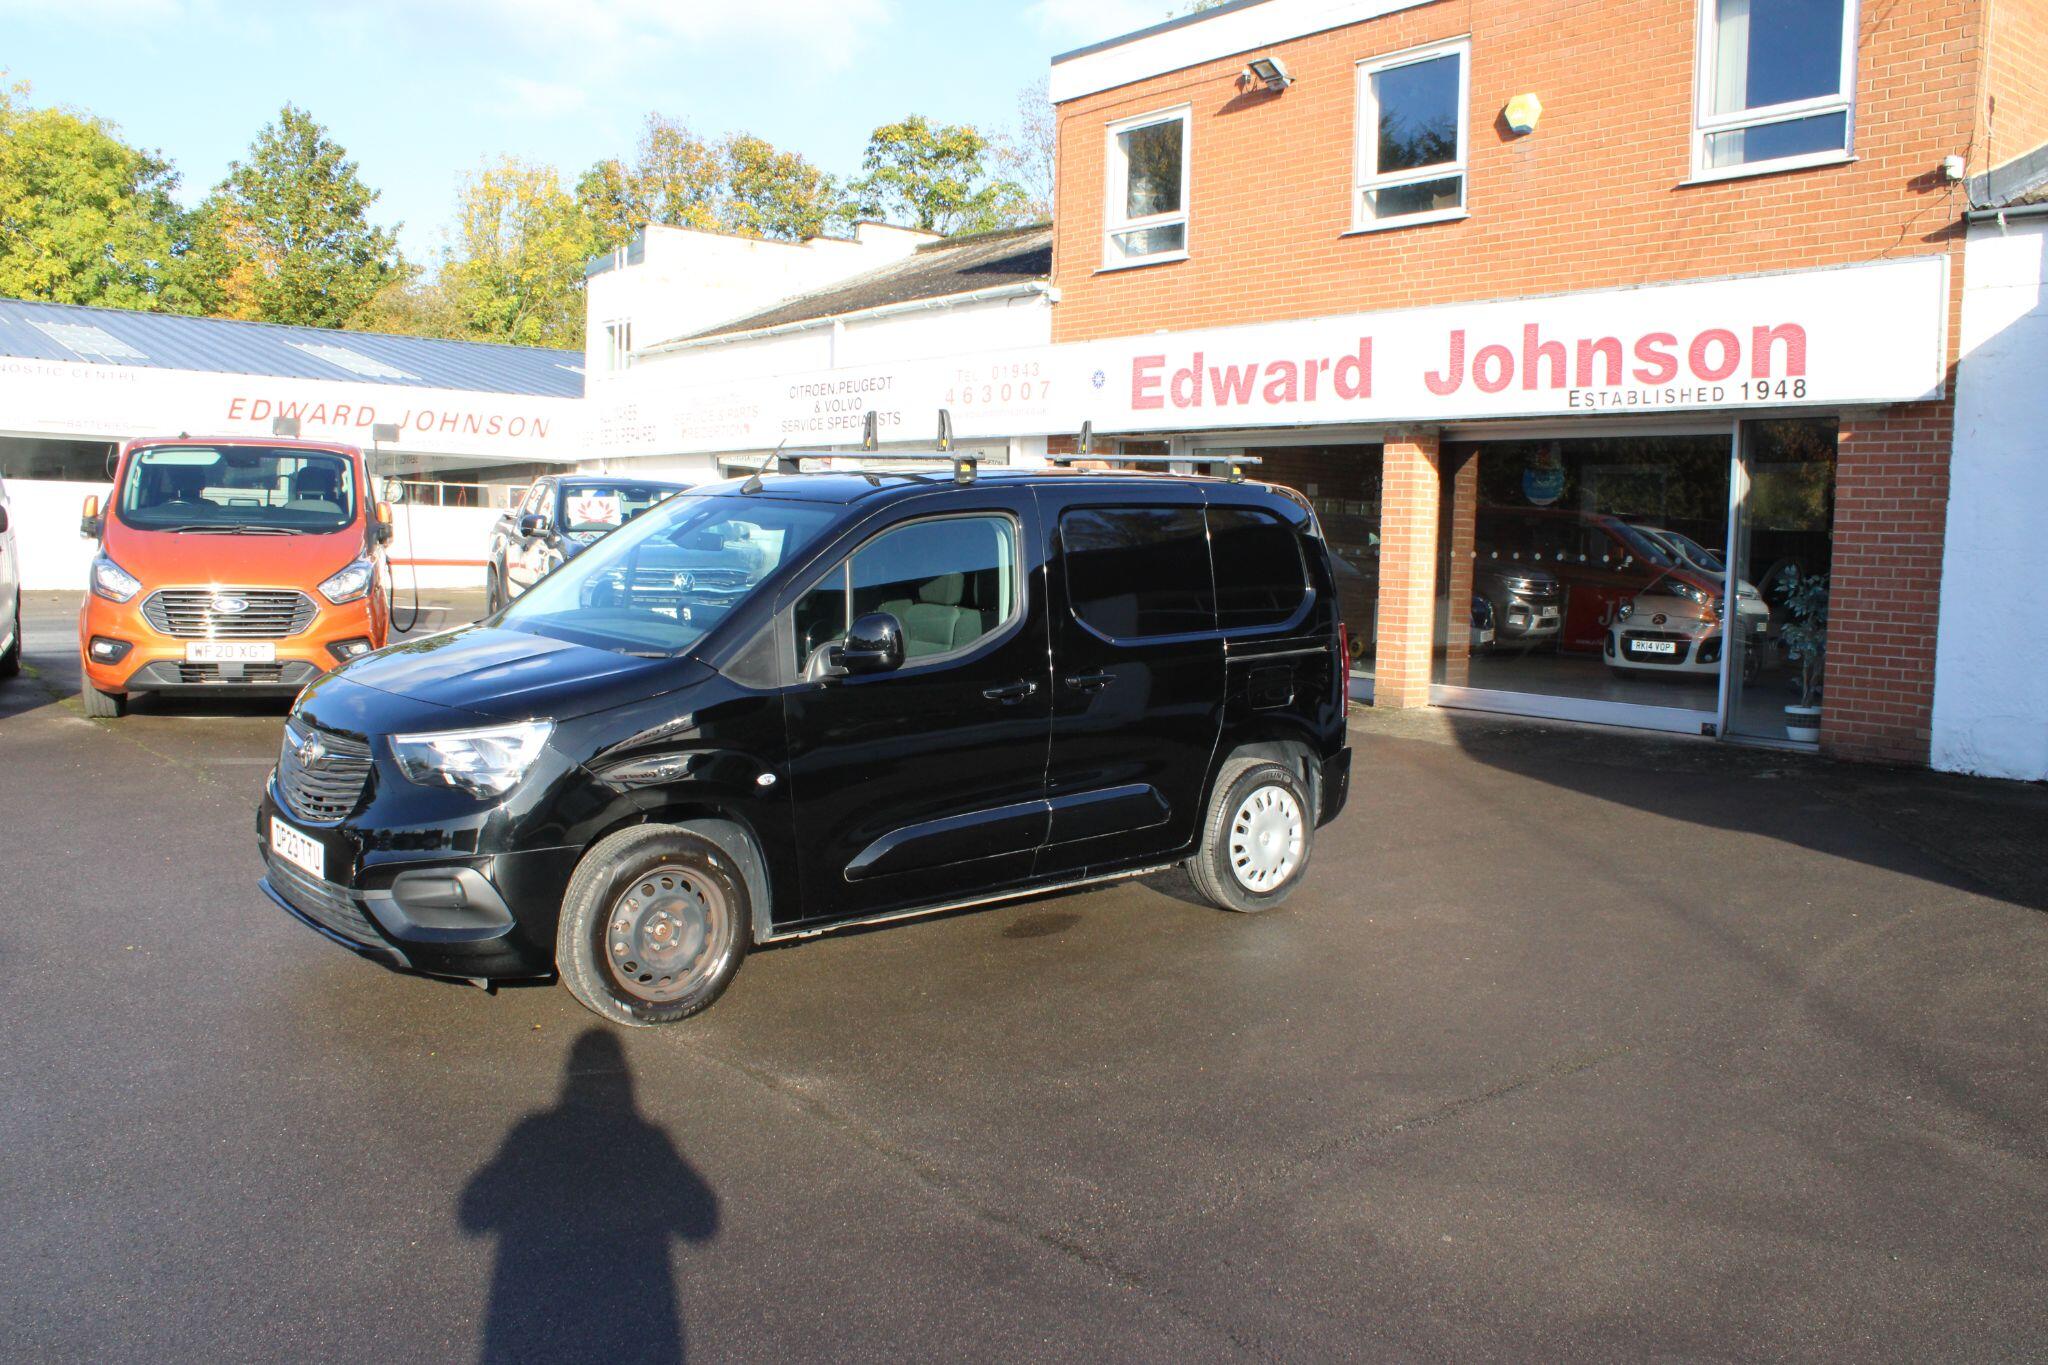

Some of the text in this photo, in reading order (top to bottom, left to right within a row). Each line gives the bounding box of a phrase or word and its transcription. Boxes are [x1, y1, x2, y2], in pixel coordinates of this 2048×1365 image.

[991, 361, 1040, 380] 01943
[1131, 321, 1807, 411] Edward Johnson
[945, 380, 1051, 405] 463007
[1569, 378, 1808, 408] ESTABLISHED 1948
[814, 397, 862, 413] & VOLVO
[227, 397, 376, 427] EDWARD
[399, 409, 551, 439] JOHNSON
[781, 412, 901, 433] SERVICE SPECIASTS
[194, 645, 234, 658] WF20
[1635, 640, 1654, 650] RK14
